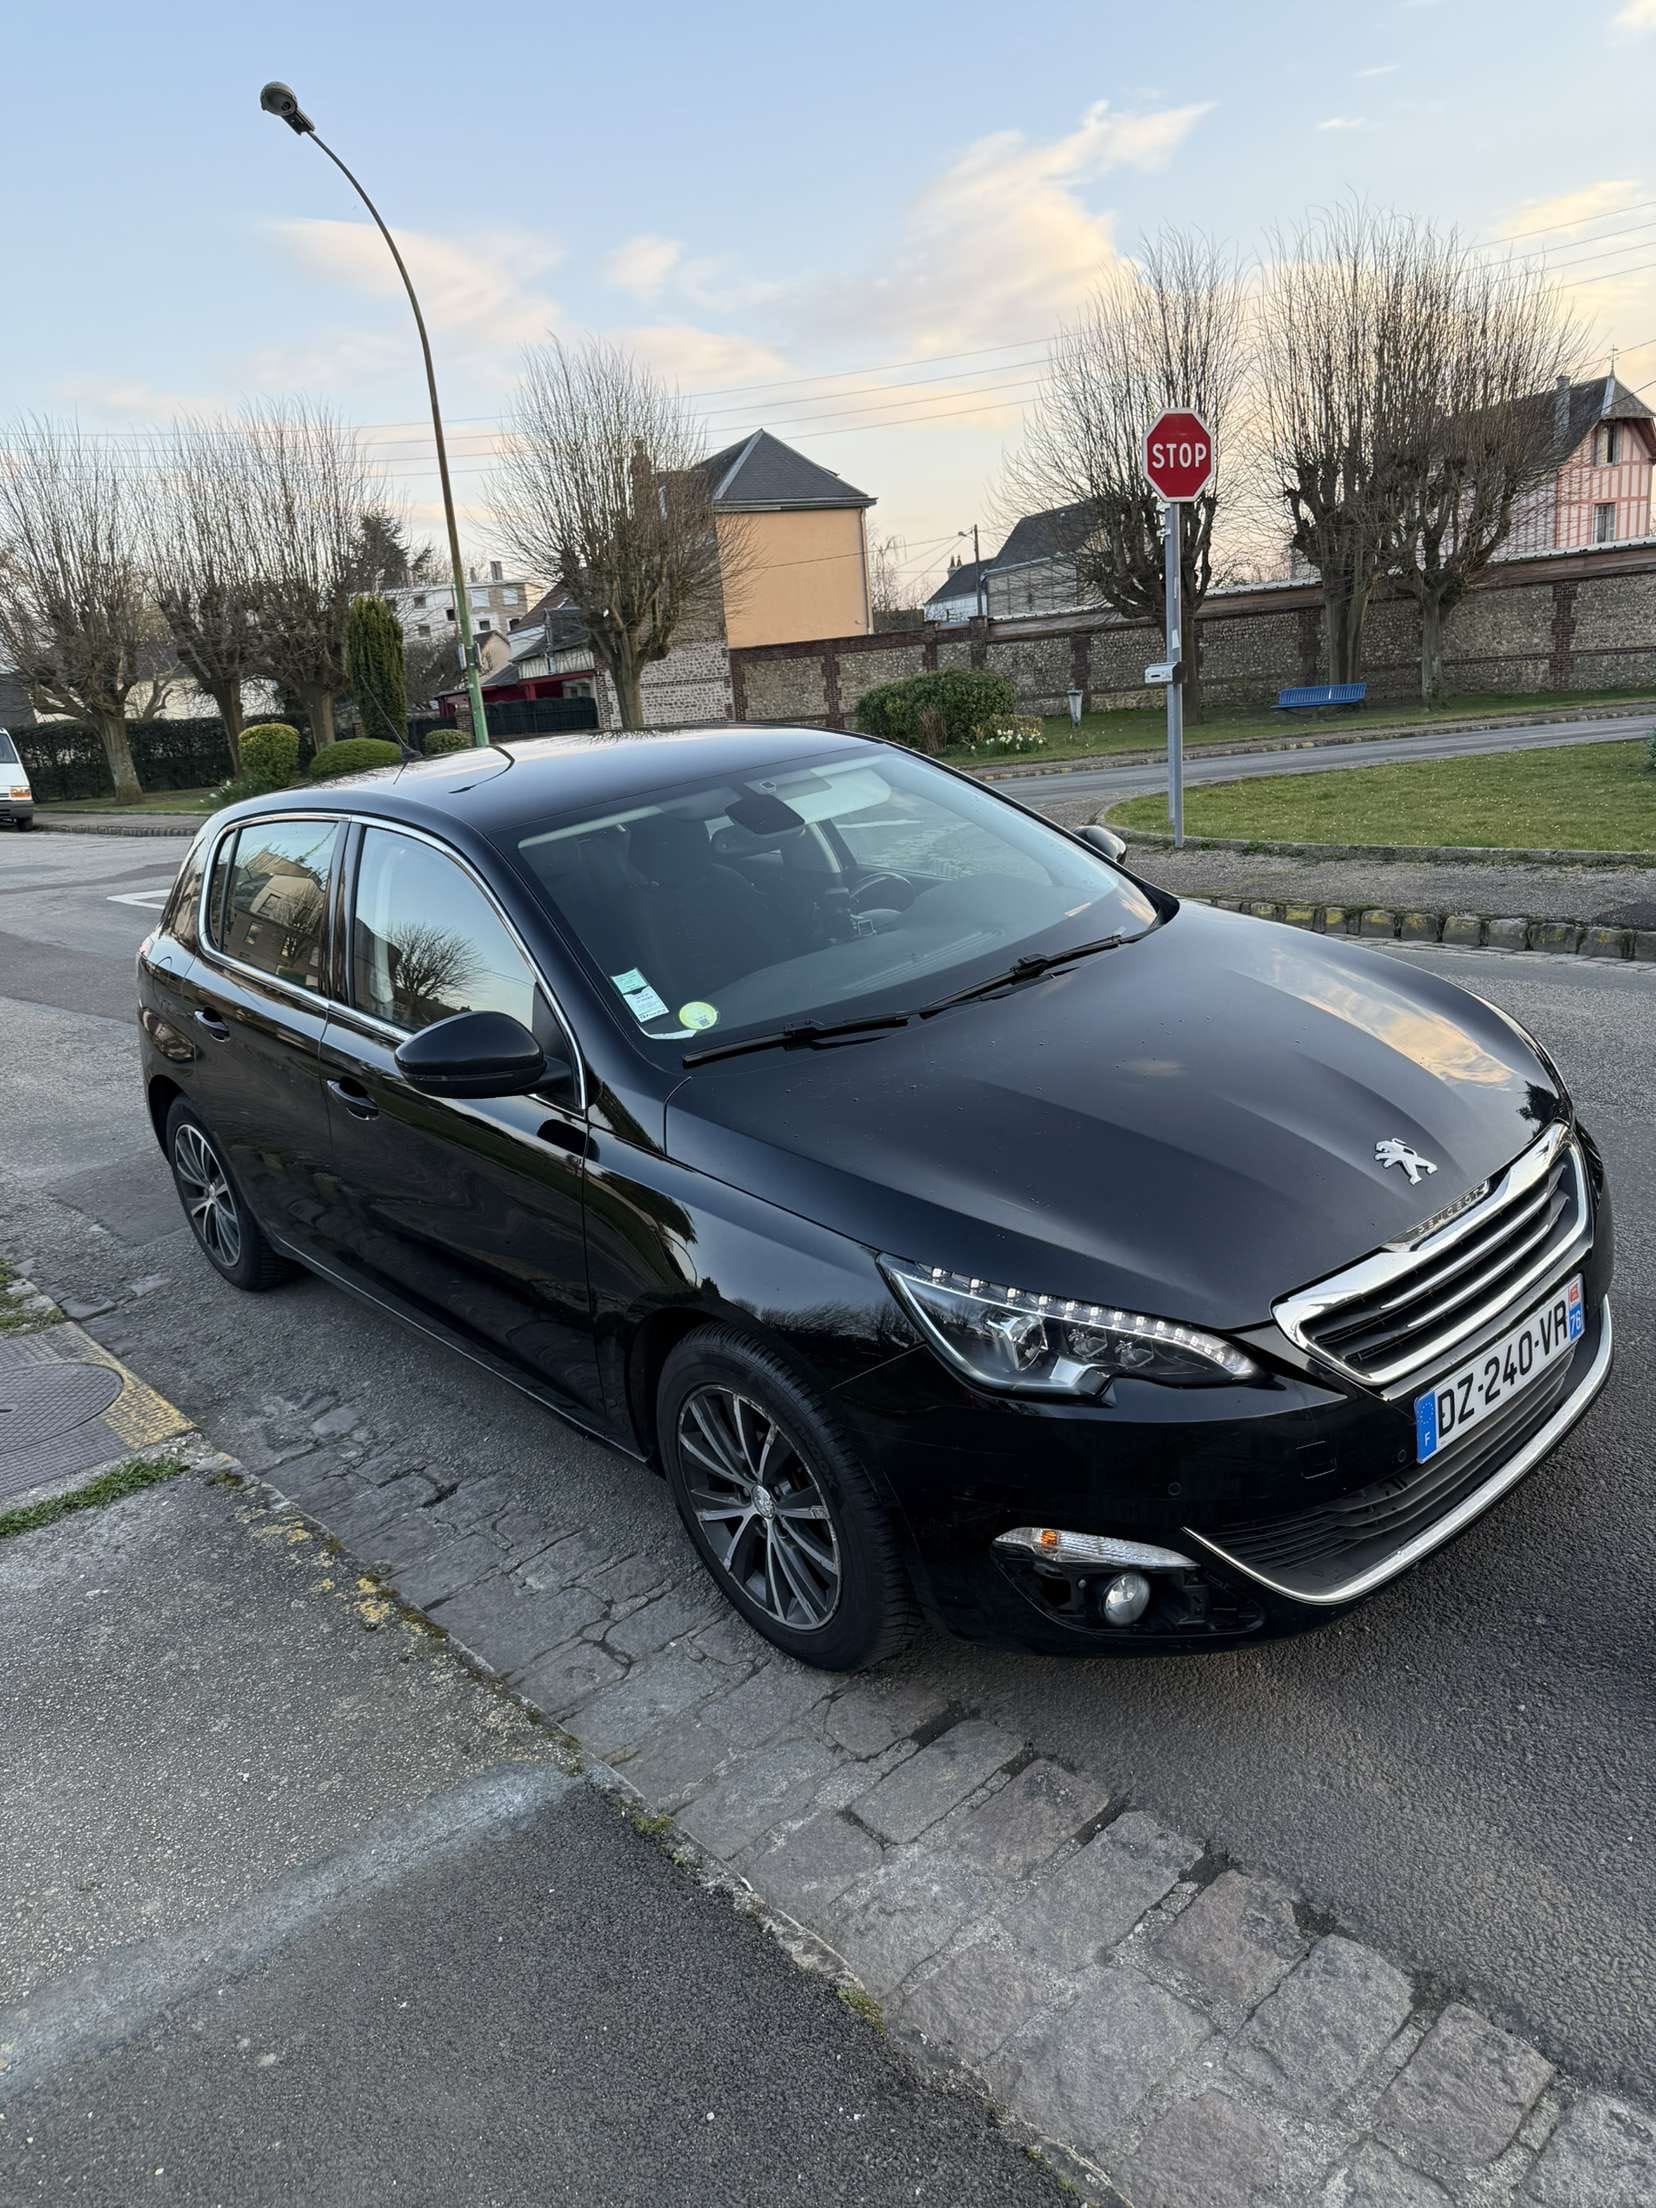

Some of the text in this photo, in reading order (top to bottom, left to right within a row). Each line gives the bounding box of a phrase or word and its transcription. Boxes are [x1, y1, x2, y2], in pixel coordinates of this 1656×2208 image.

[1151, 442, 1207, 469] STOP
[1424, 1431, 1431, 1447] F
[1437, 1300, 1568, 1438] DZ-240-VR
